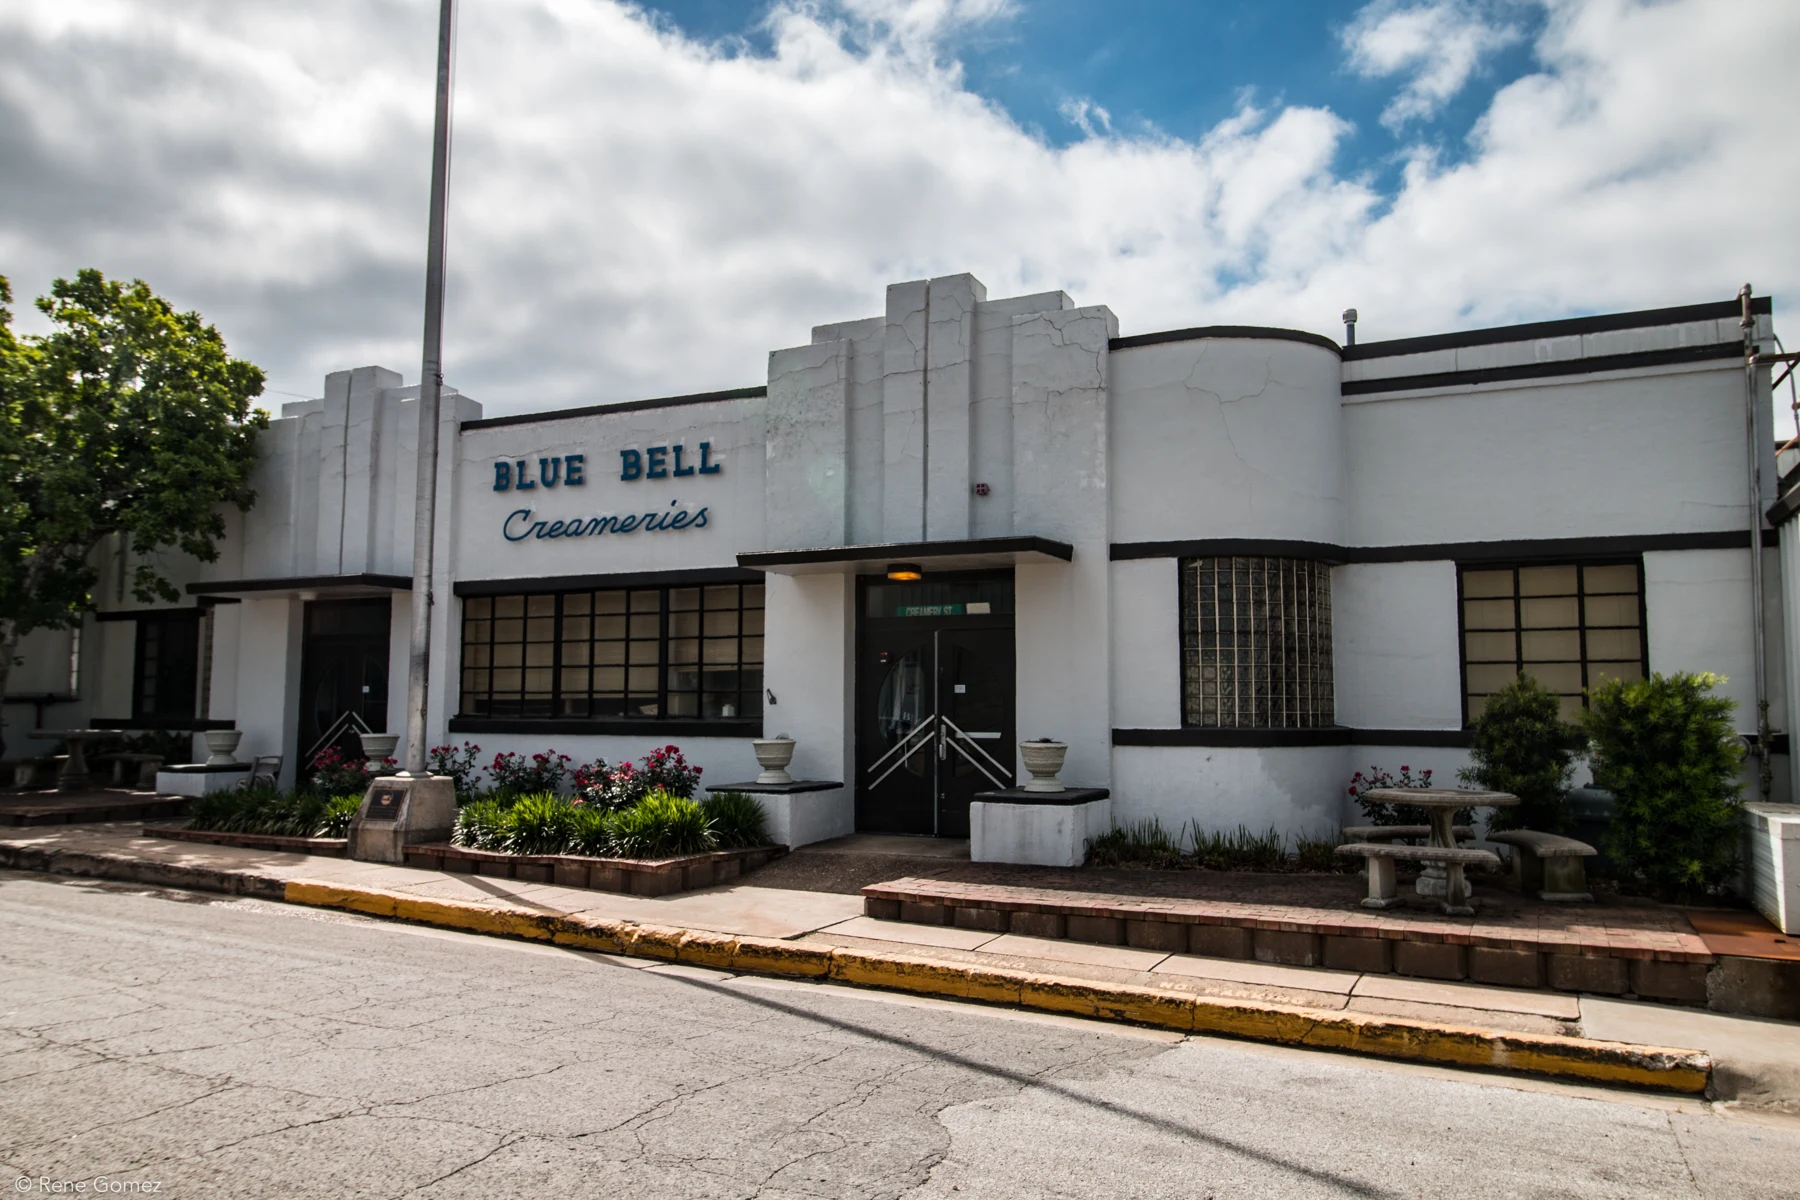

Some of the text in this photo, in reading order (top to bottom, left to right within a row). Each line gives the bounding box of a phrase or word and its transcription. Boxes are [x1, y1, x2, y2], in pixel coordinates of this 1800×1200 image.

[493, 441, 720, 491] BLUE BELL
[503, 499, 709, 542] Creameries
[905, 605, 953, 617] CREAMERY ST
[1159, 981, 1188, 991] NO
